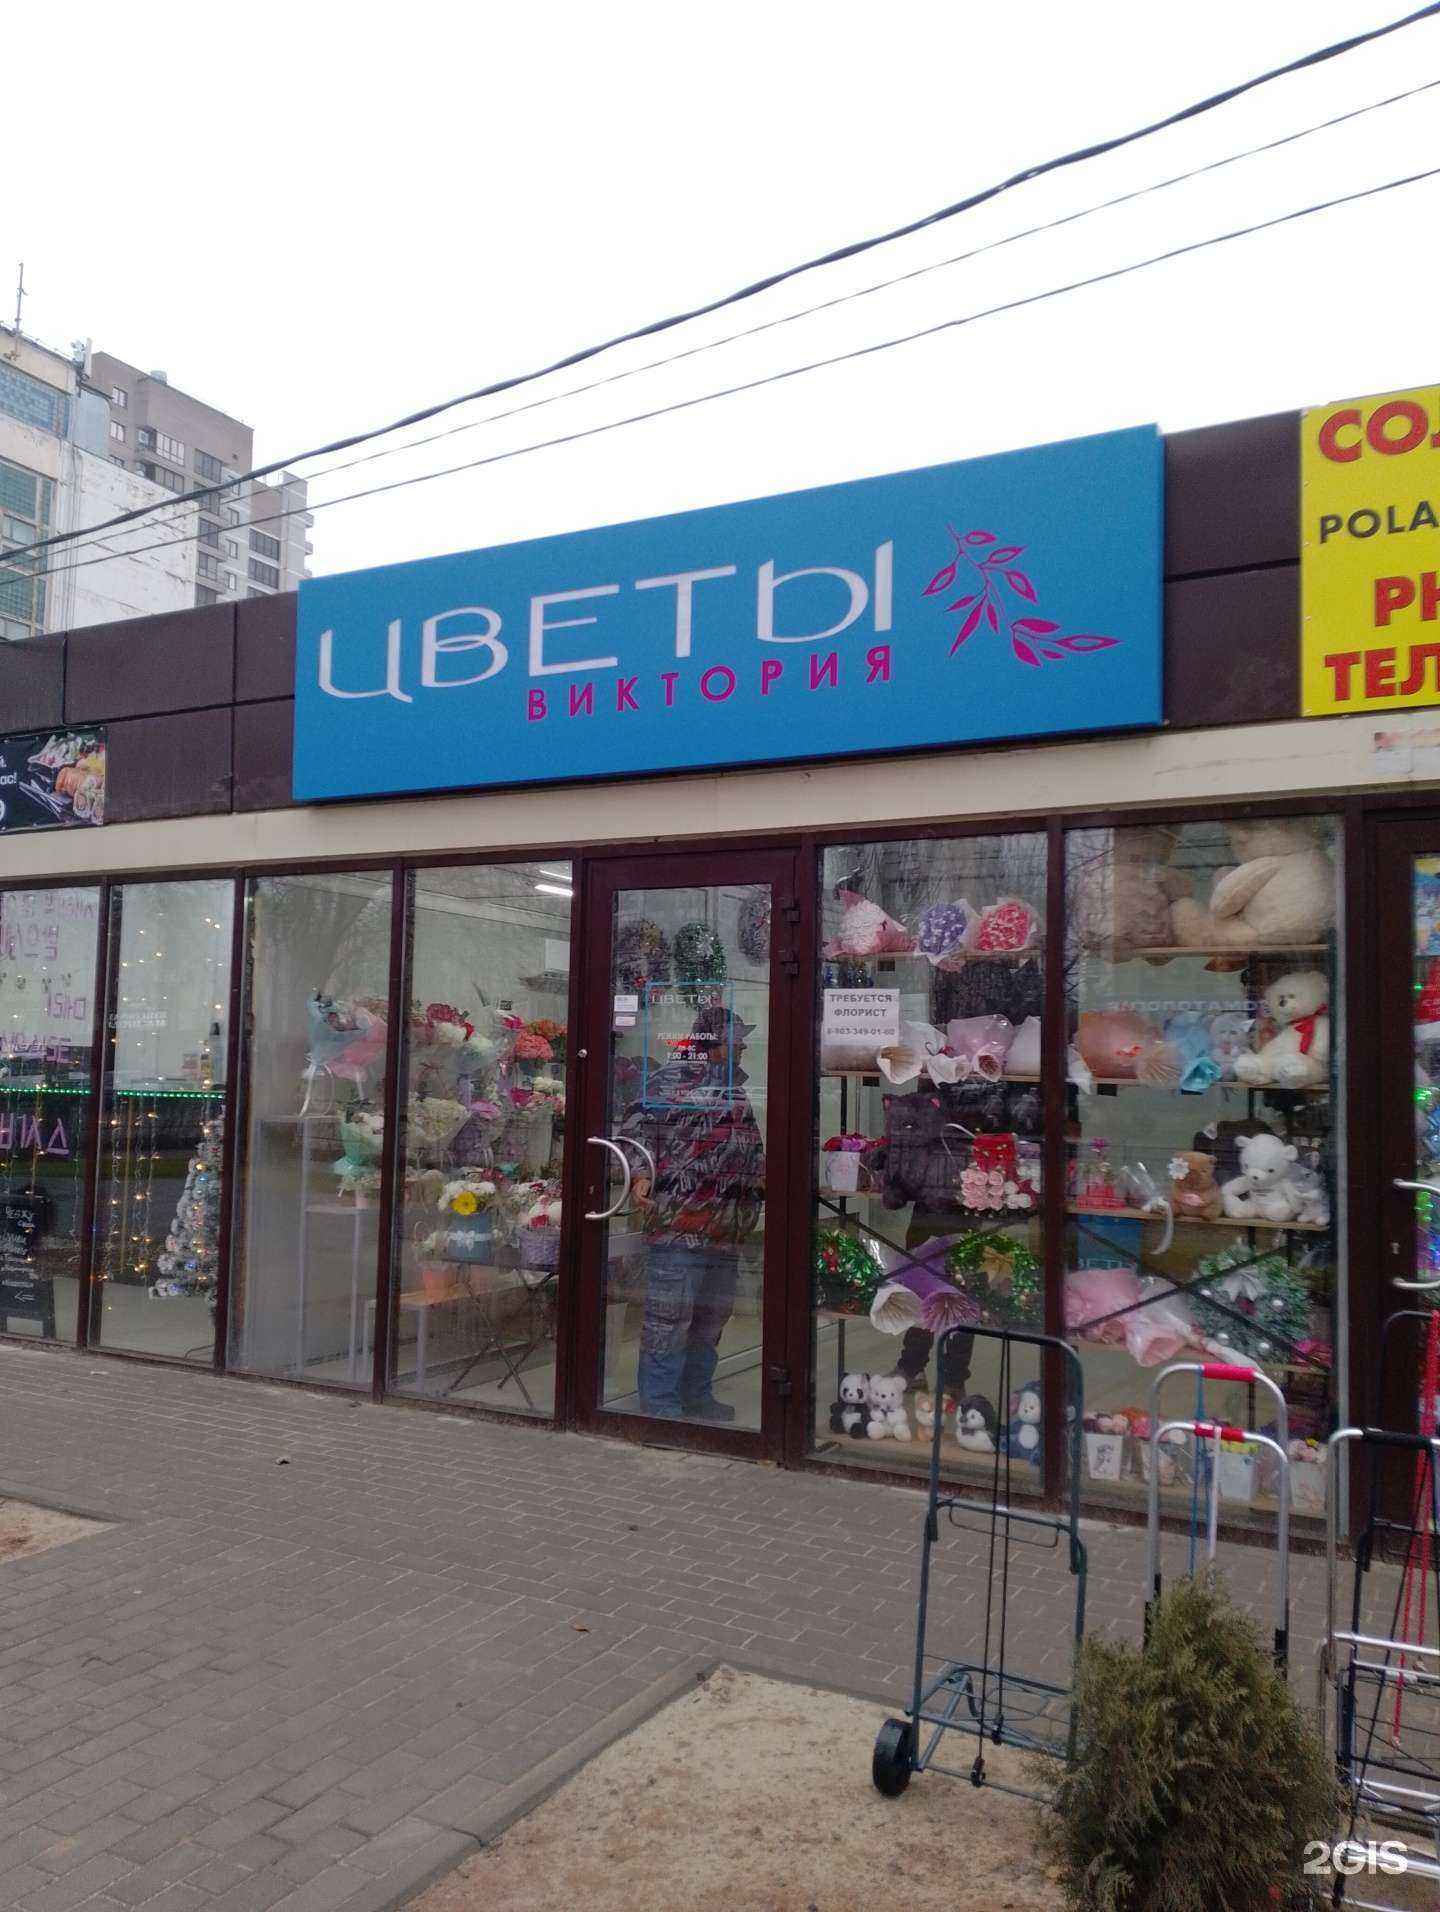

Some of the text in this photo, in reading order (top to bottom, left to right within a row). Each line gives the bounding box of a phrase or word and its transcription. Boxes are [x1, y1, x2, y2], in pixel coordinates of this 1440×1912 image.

[1318, 400, 1440, 463] СО
[317, 540, 893, 704] ЦВЕТЫ
[526, 644, 893, 721] ВИКТОРИЯ
[829, 994, 893, 1003] ТРЕБУЕТСЯ
[834, 1008, 888, 1017] ФЛОРИСТ
